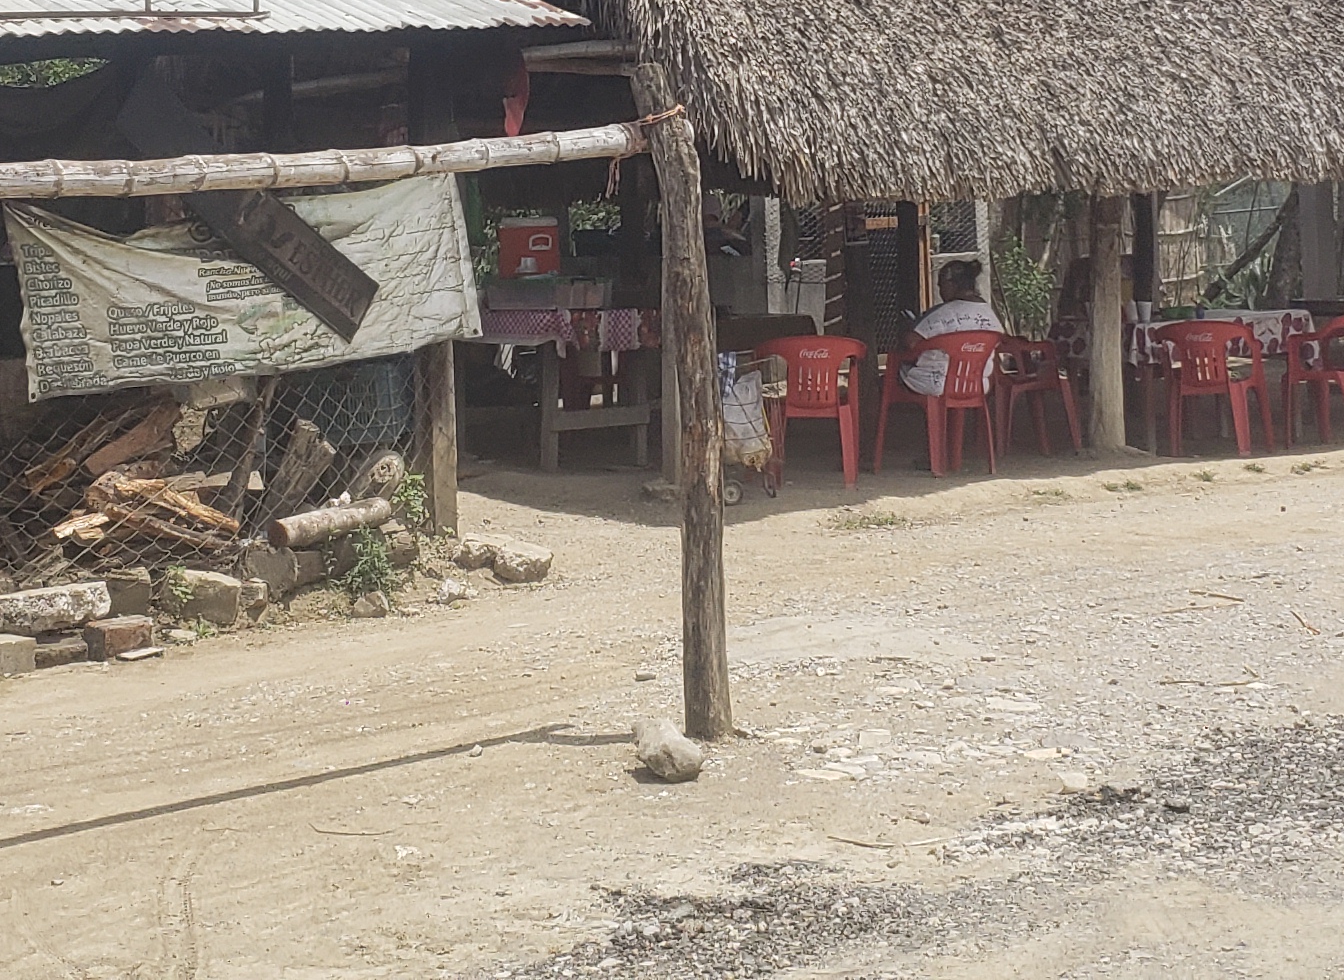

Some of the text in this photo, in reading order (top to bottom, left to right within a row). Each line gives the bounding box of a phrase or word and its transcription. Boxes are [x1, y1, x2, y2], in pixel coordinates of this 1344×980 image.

[25, 261, 59, 273] Bistec
[27, 277, 71, 290] Chorizo
[29, 292, 78, 307] Picadillo
[153, 303, 195, 317] Frijoles
[32, 310, 79, 325] Nopales
[110, 322, 145, 335] Huevo
[192, 317, 218, 332] Rojo
[141, 338, 175, 349] Verde
[176, 338, 185, 350] y
[185, 332, 227, 347] Natural
[166, 351, 203, 363] Puerco
[205, 350, 220, 359] en
